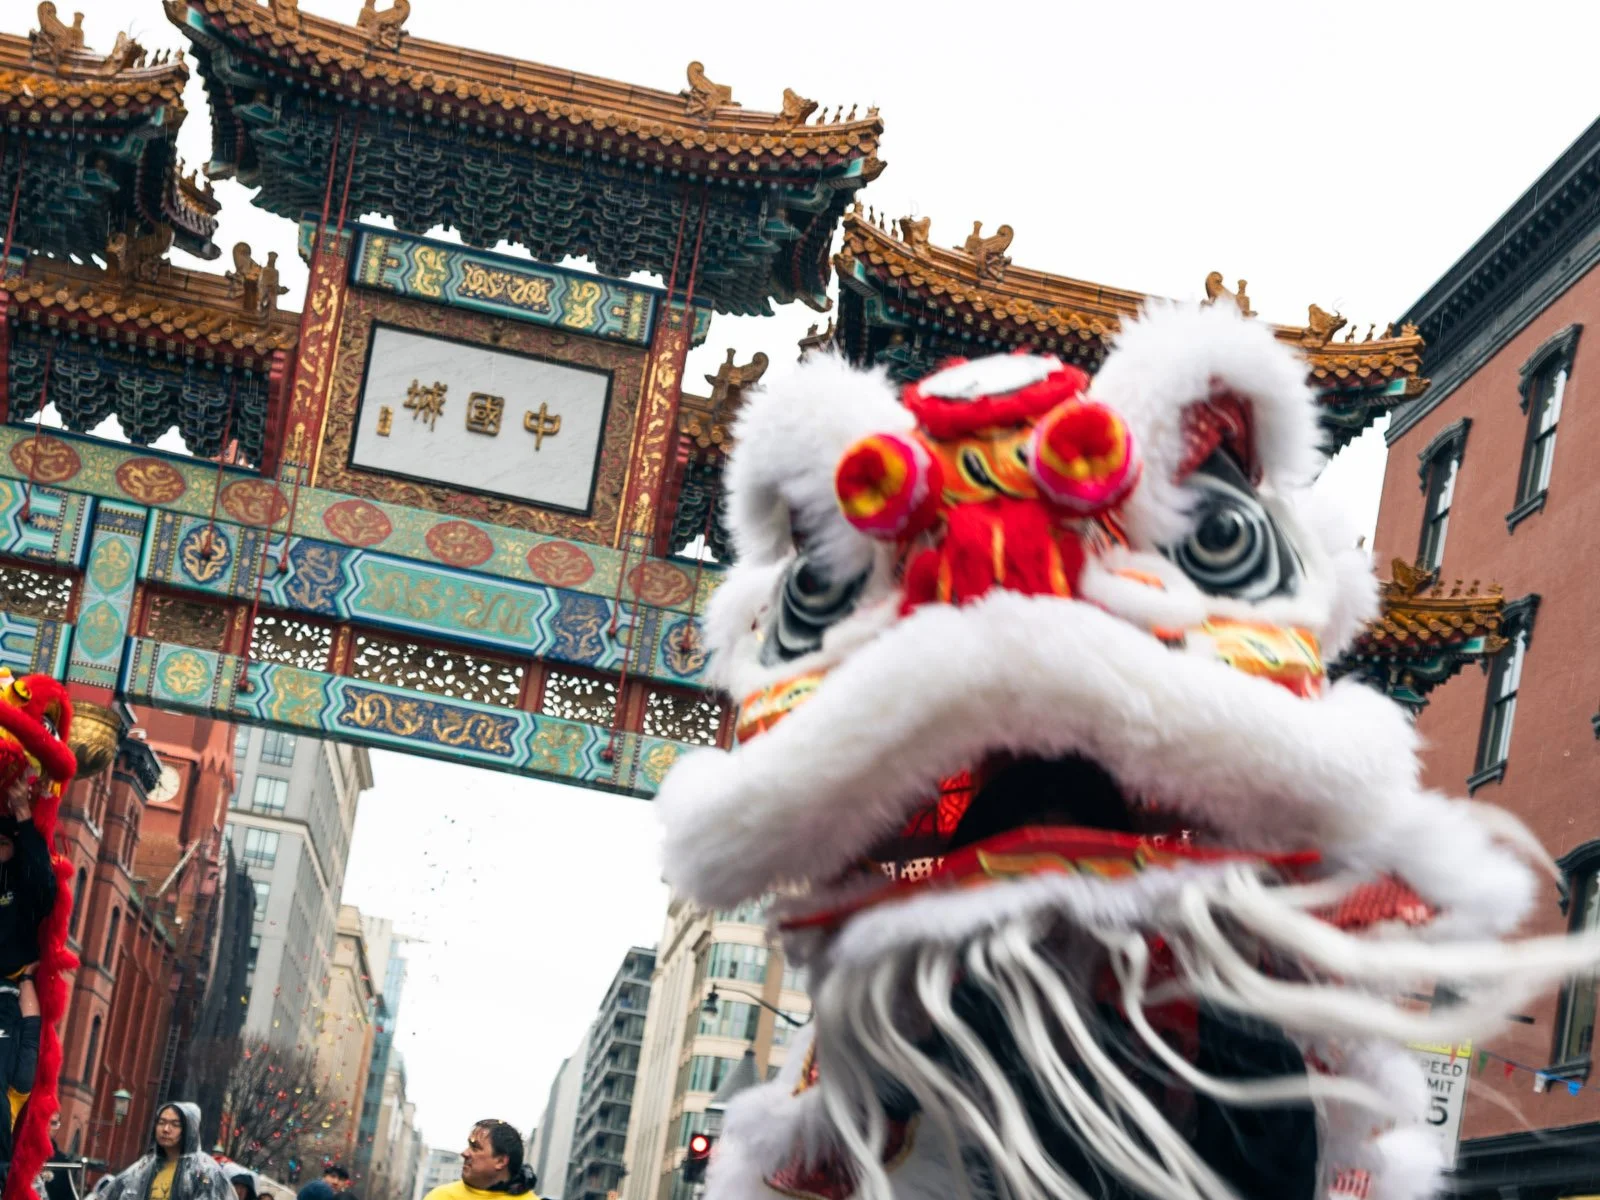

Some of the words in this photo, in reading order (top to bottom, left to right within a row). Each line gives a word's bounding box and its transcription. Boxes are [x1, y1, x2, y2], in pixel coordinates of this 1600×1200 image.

[1420, 1058, 1463, 1078] PEED
[1426, 1077, 1456, 1094] MIT
[1425, 1095, 1449, 1126] 5
